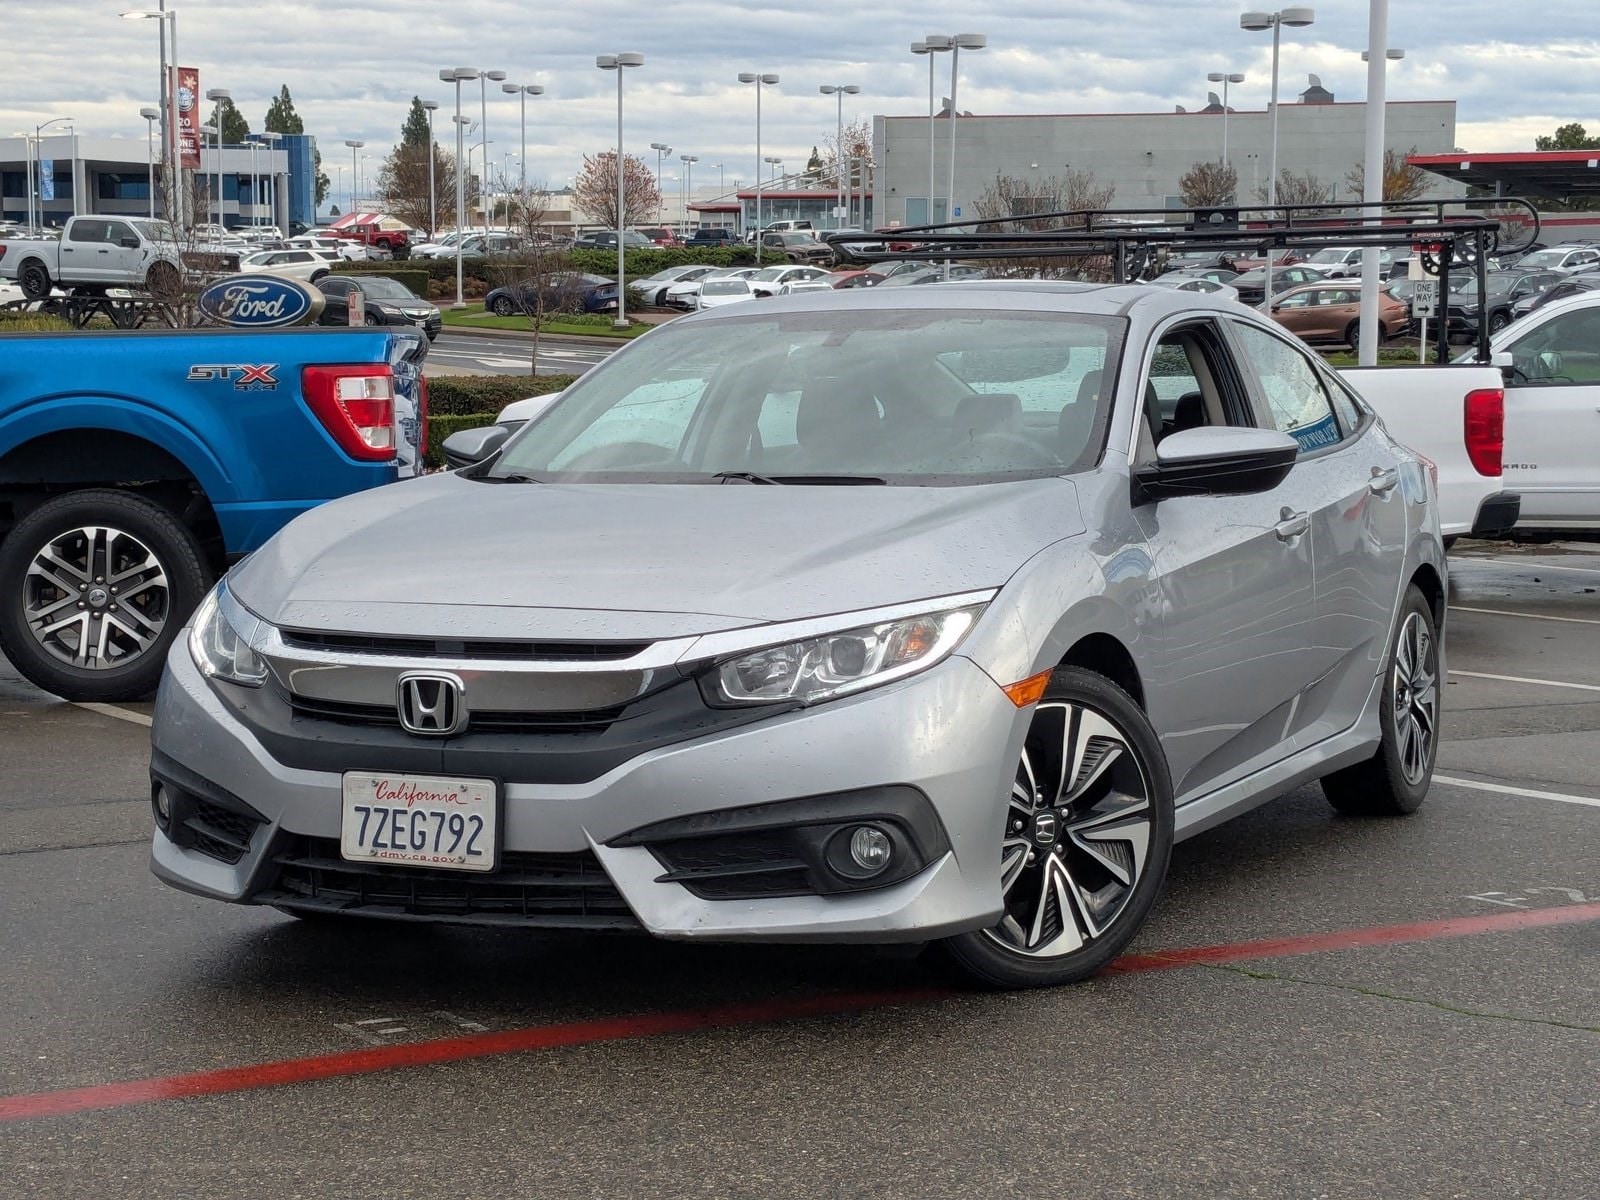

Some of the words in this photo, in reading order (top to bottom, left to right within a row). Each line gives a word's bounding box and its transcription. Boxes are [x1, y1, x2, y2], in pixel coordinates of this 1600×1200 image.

[1415, 293, 1433, 302] WAY
[1416, 283, 1432, 292] ONE
[218, 286, 287, 318] Ford
[186, 363, 280, 385] STX
[375, 779, 468, 807] California
[354, 805, 484, 856] 7ZEG792
[380, 851, 458, 863] dmv.ca.gov
